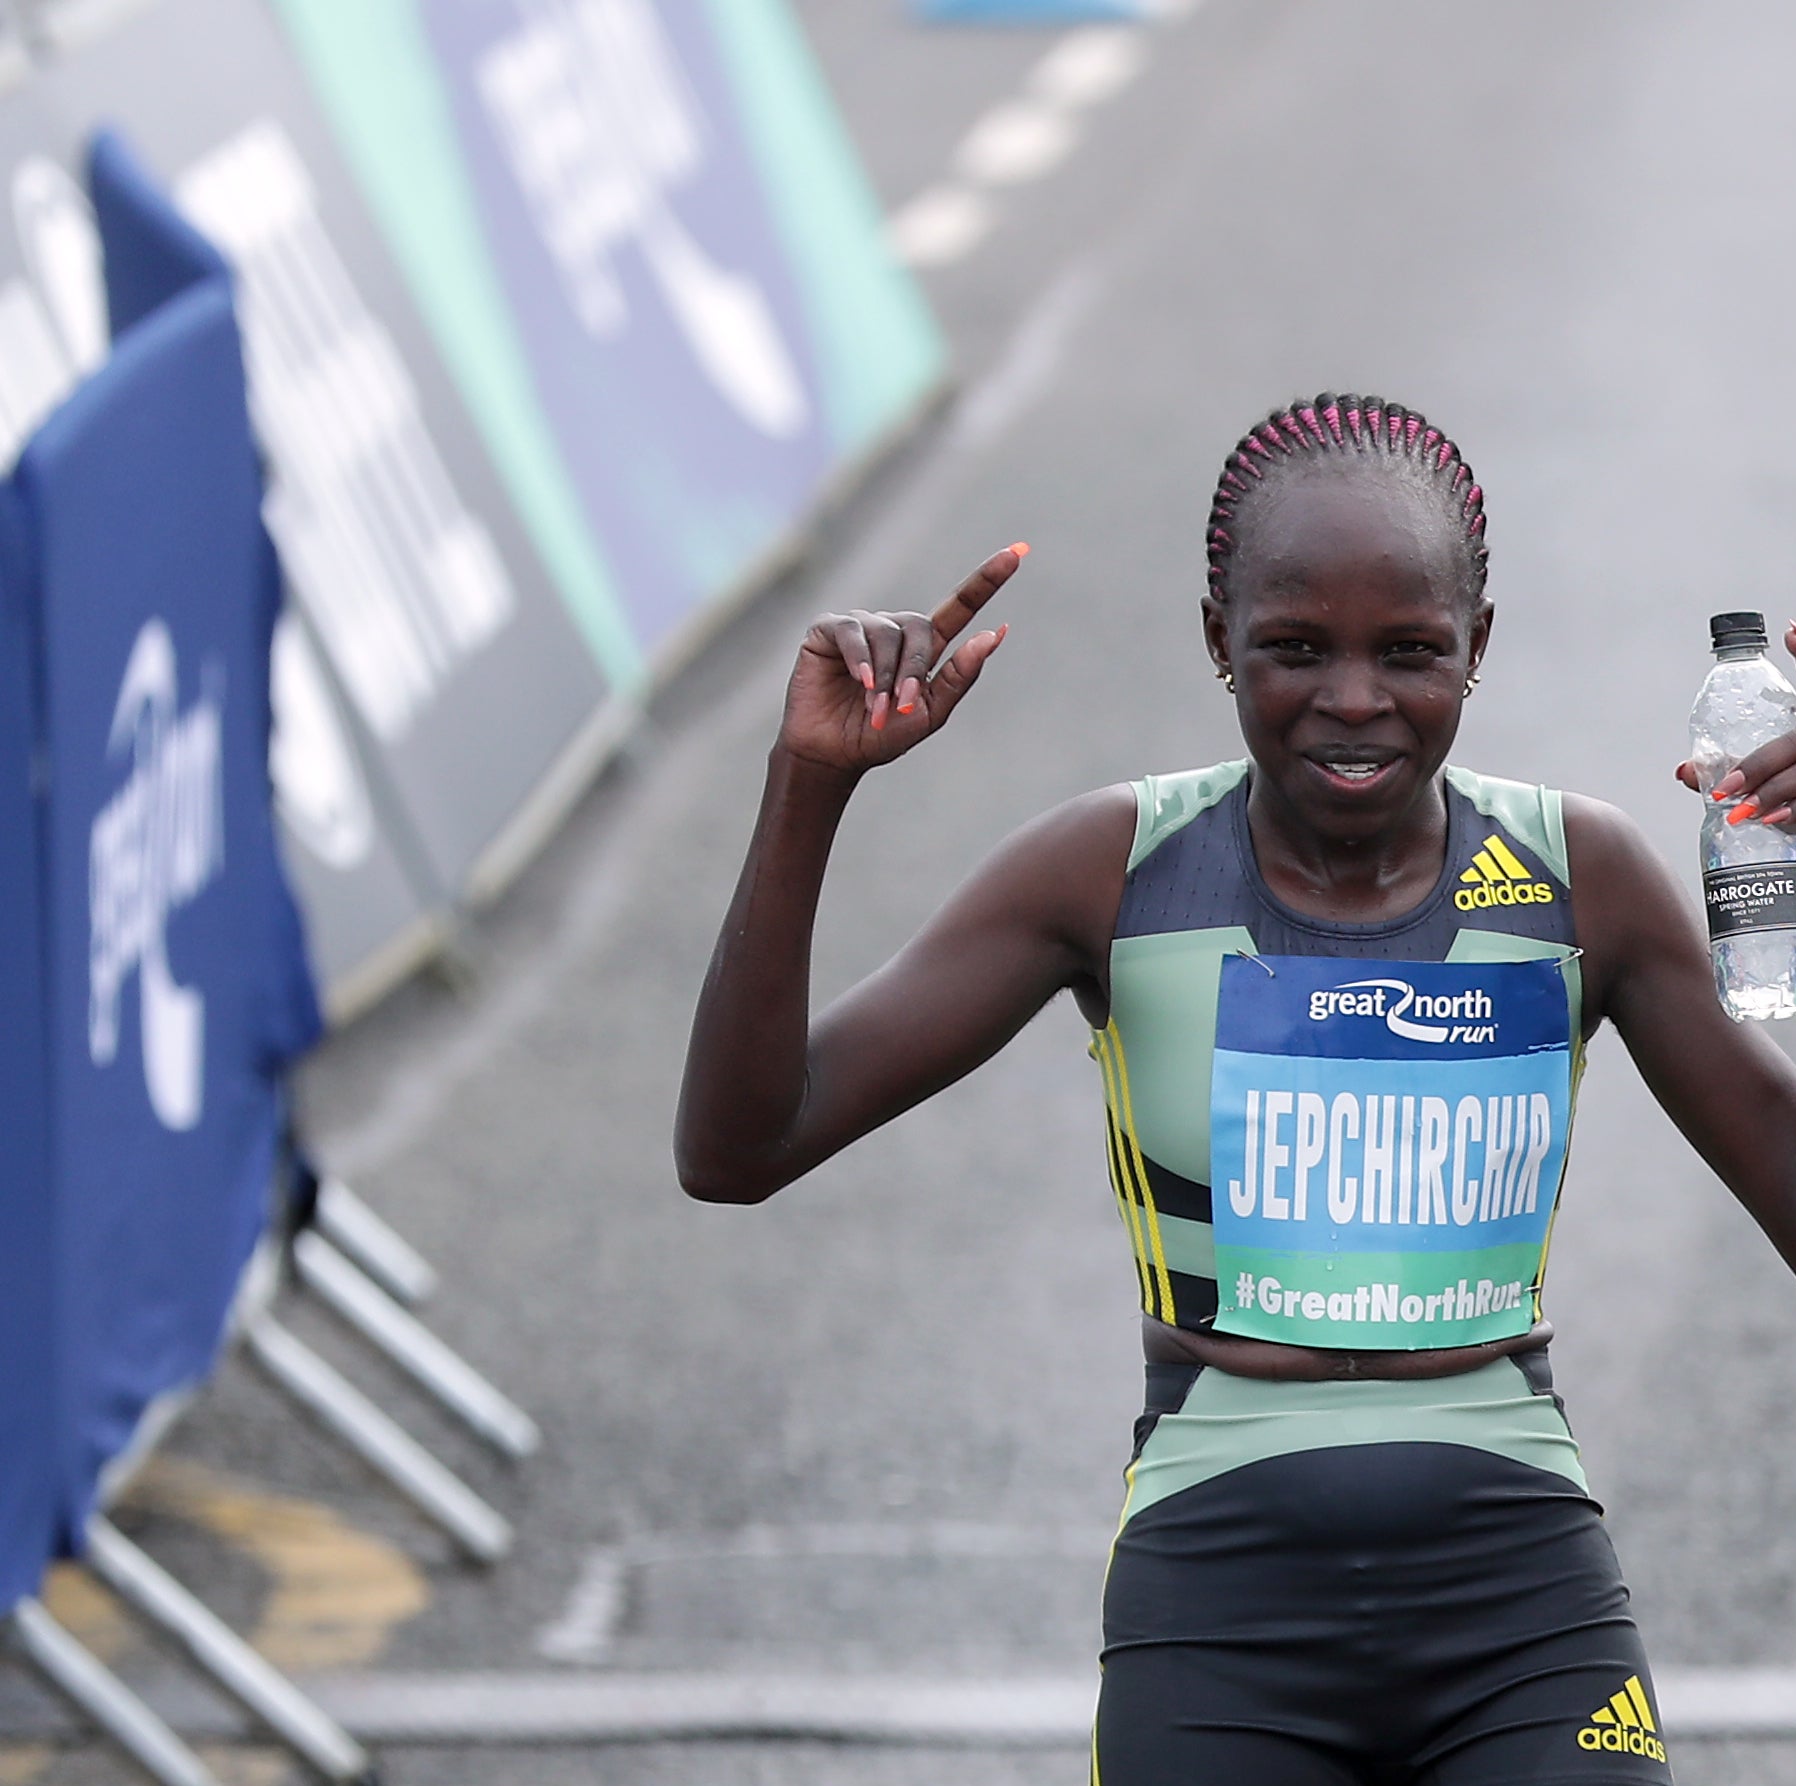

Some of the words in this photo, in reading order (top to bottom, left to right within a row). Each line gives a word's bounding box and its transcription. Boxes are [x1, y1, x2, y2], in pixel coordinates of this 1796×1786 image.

[1454, 879, 1554, 911] adidas
[1706, 879, 1795, 904] HARROGATE
[1719, 899, 1746, 911] SPRING
[1747, 897, 1775, 907] WATER
[1309, 988, 1387, 1021] great
[1414, 989, 1492, 1019] north
[1449, 1025, 1496, 1044] run
[1228, 1089, 1550, 1227] JEPCHIRCHIR
[1235, 1271, 1523, 1323] #GreatNorthRun
[1577, 1722, 1667, 1764] adidas
